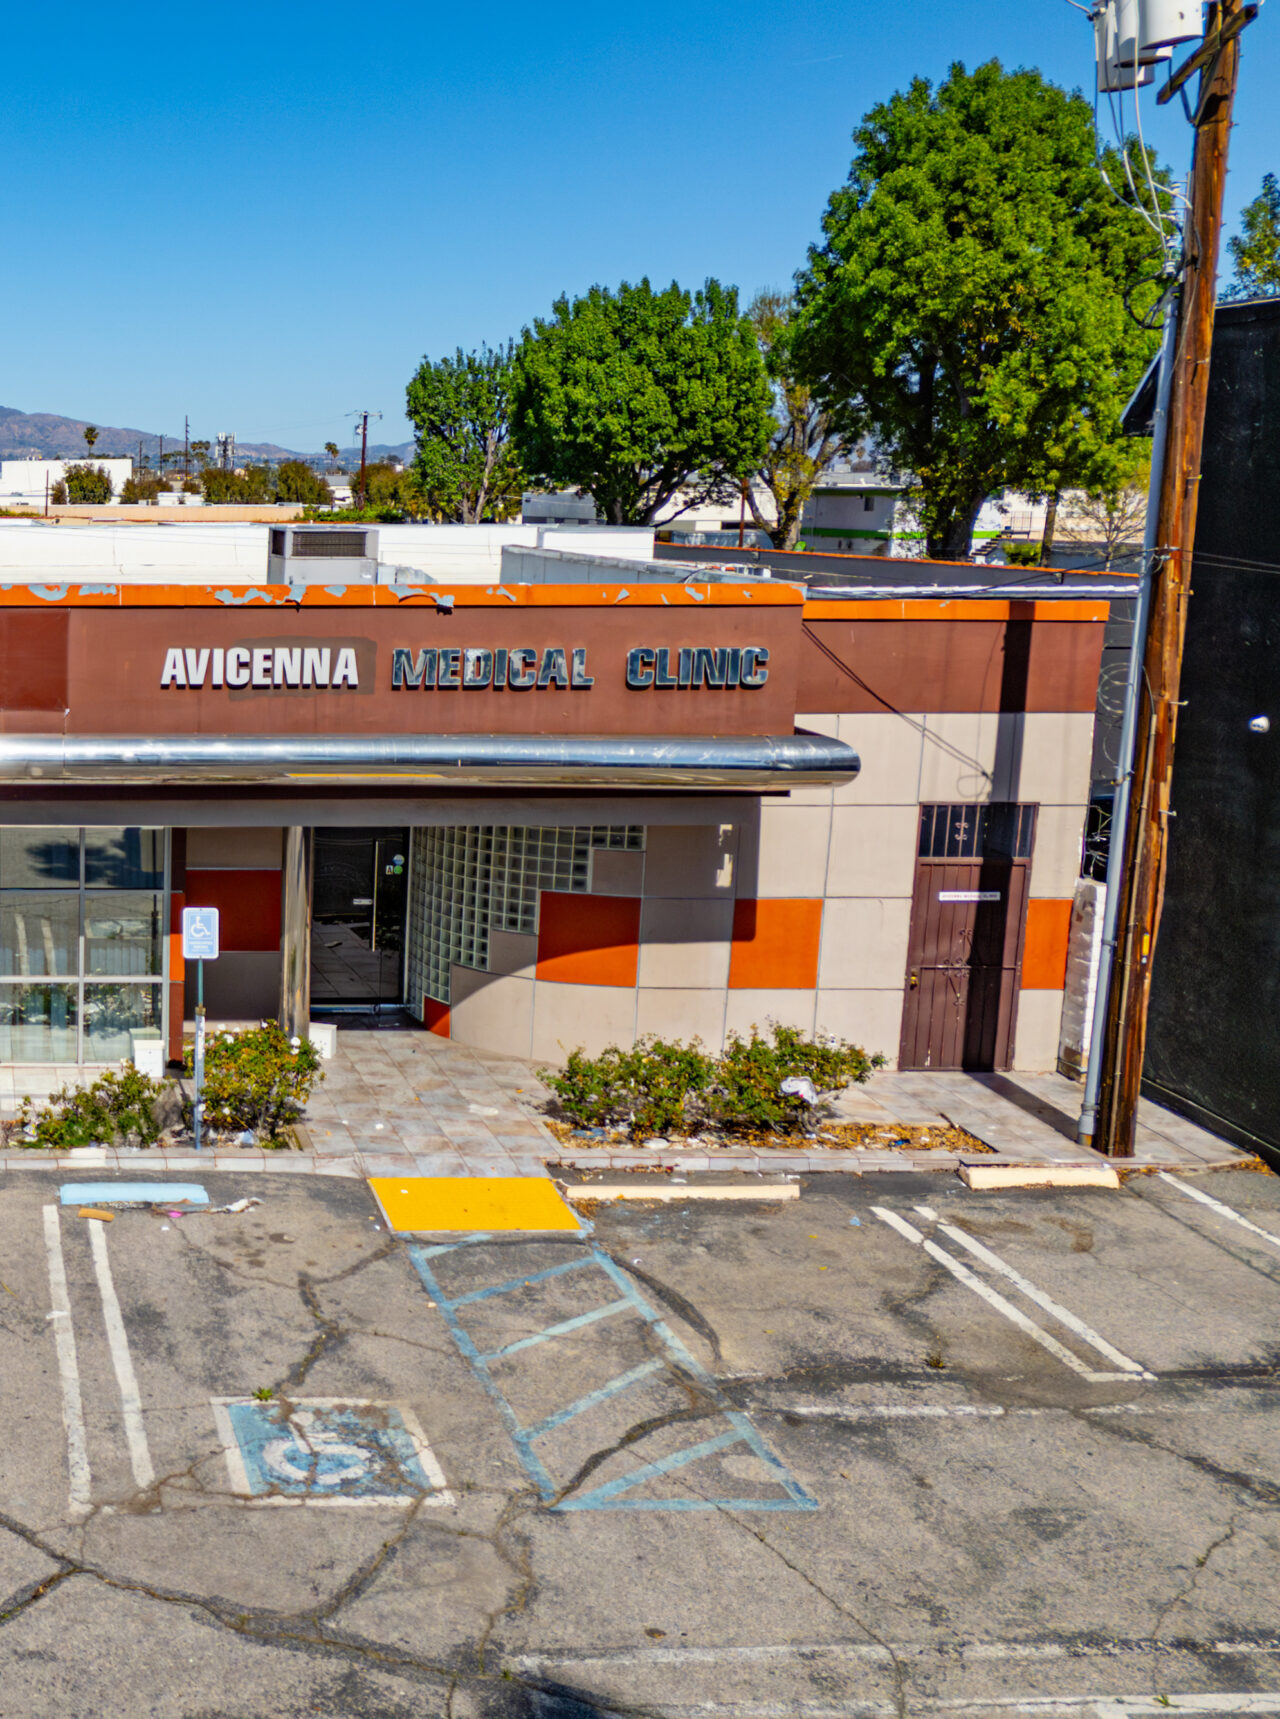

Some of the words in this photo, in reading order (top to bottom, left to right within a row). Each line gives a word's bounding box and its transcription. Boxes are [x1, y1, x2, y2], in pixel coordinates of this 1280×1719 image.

[160, 647, 358, 687] AVICENNA
[392, 647, 594, 688] MEDICAL
[626, 647, 769, 688] CLINIC
